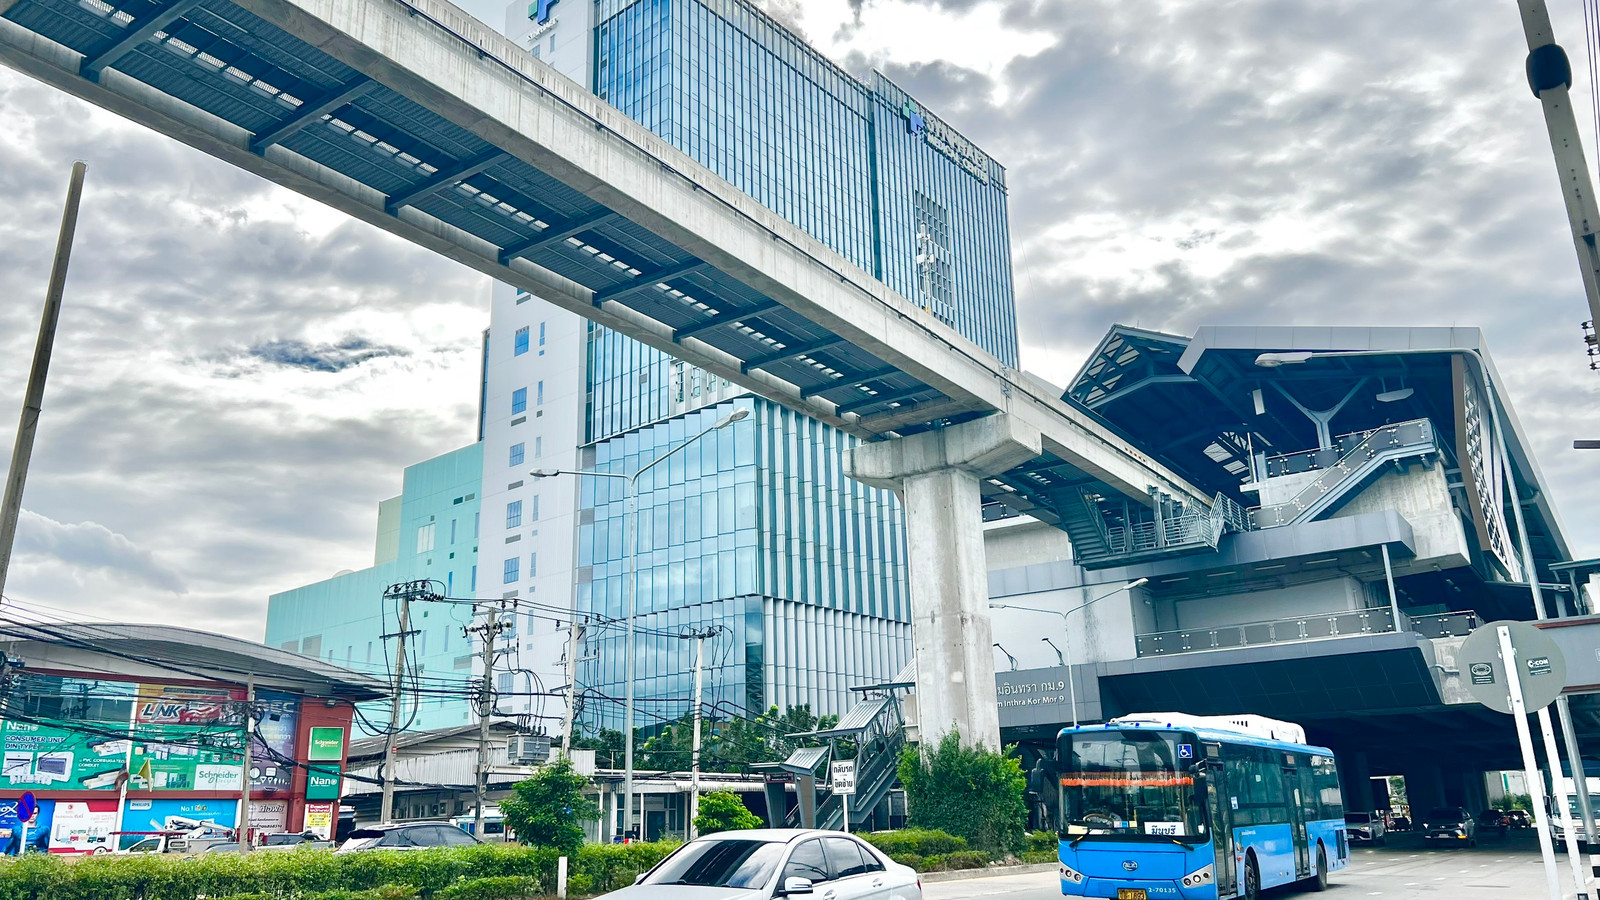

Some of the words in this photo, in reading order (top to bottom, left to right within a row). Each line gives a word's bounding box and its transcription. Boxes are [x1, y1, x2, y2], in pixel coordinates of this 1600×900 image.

[1041, 681, 1065, 692] กม.9
[1004, 698, 1026, 707] Inthra
[1027, 697, 1041, 706] Kor
[1042, 696, 1058, 704] Mor
[1058, 695, 1065, 703] 9
[142, 702, 182, 720] LINK
[5, 735, 47, 743] CONSUMER
[199, 771, 239, 783] Schneider
[310, 776, 338, 785] Nano
